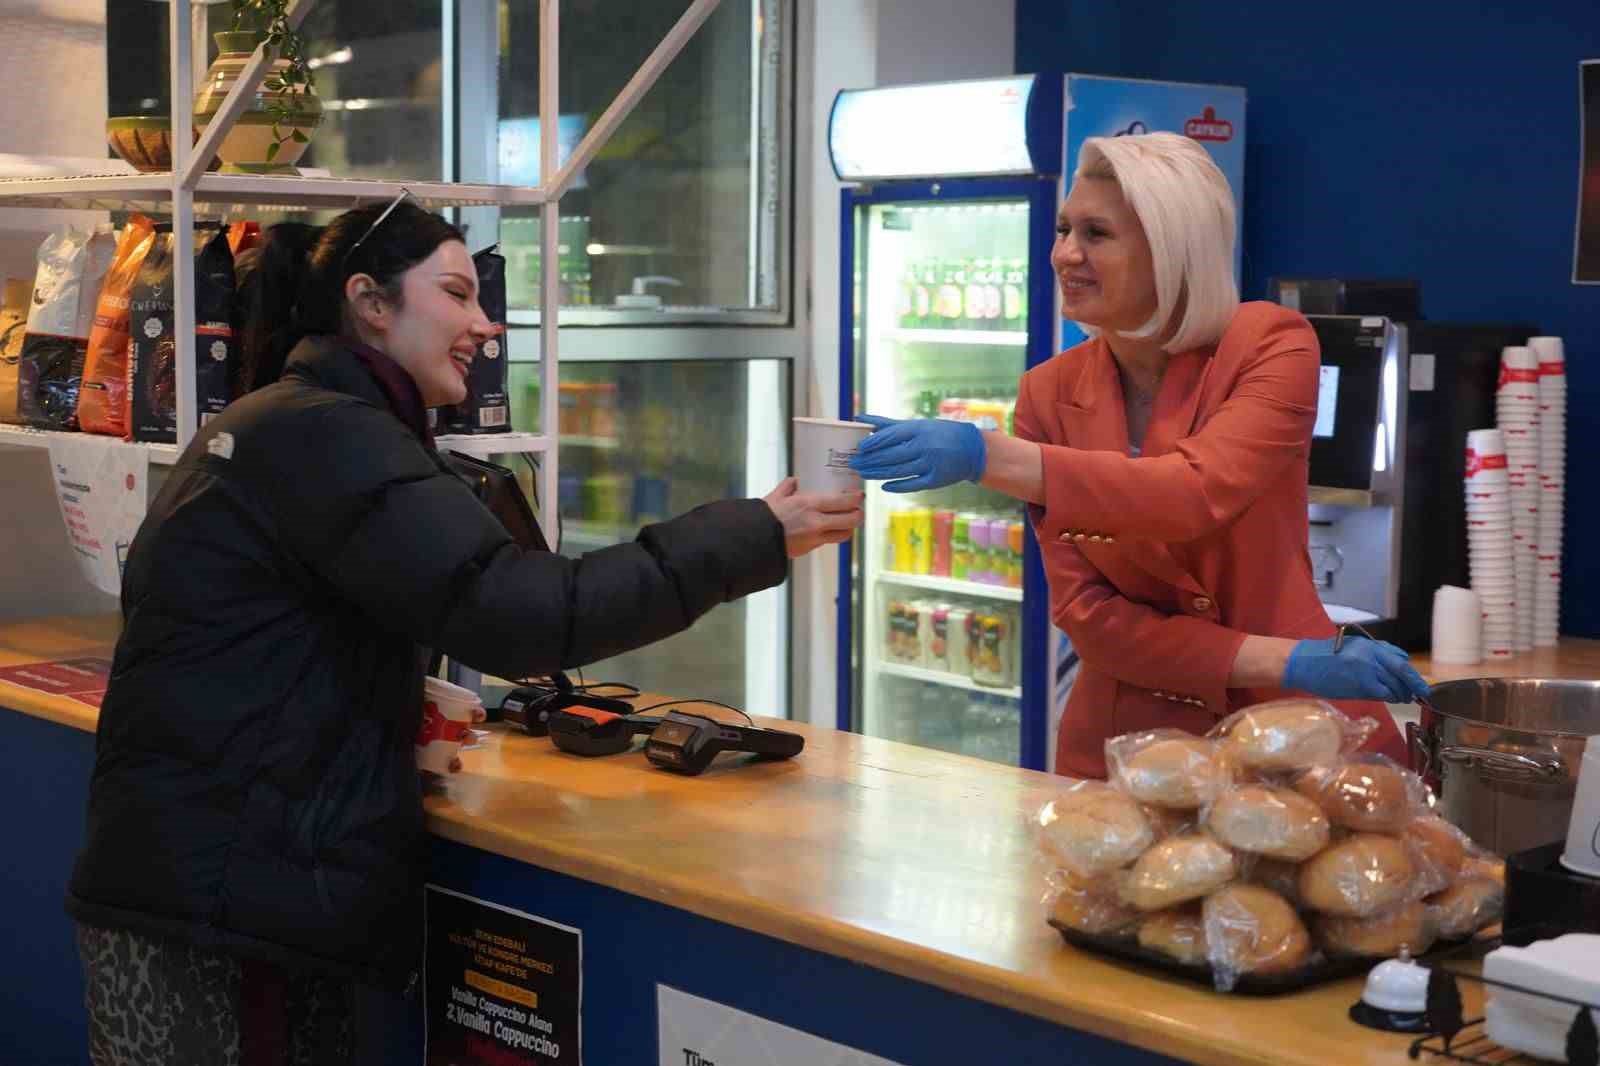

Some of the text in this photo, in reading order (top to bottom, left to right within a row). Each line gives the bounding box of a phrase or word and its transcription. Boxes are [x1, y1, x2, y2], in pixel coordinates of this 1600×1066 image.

[451, 985, 477, 1007] Vanilla
[479, 997, 526, 1024] Cappuccino
[446, 1003, 560, 1059] 2.Vanilla Cappuccino
